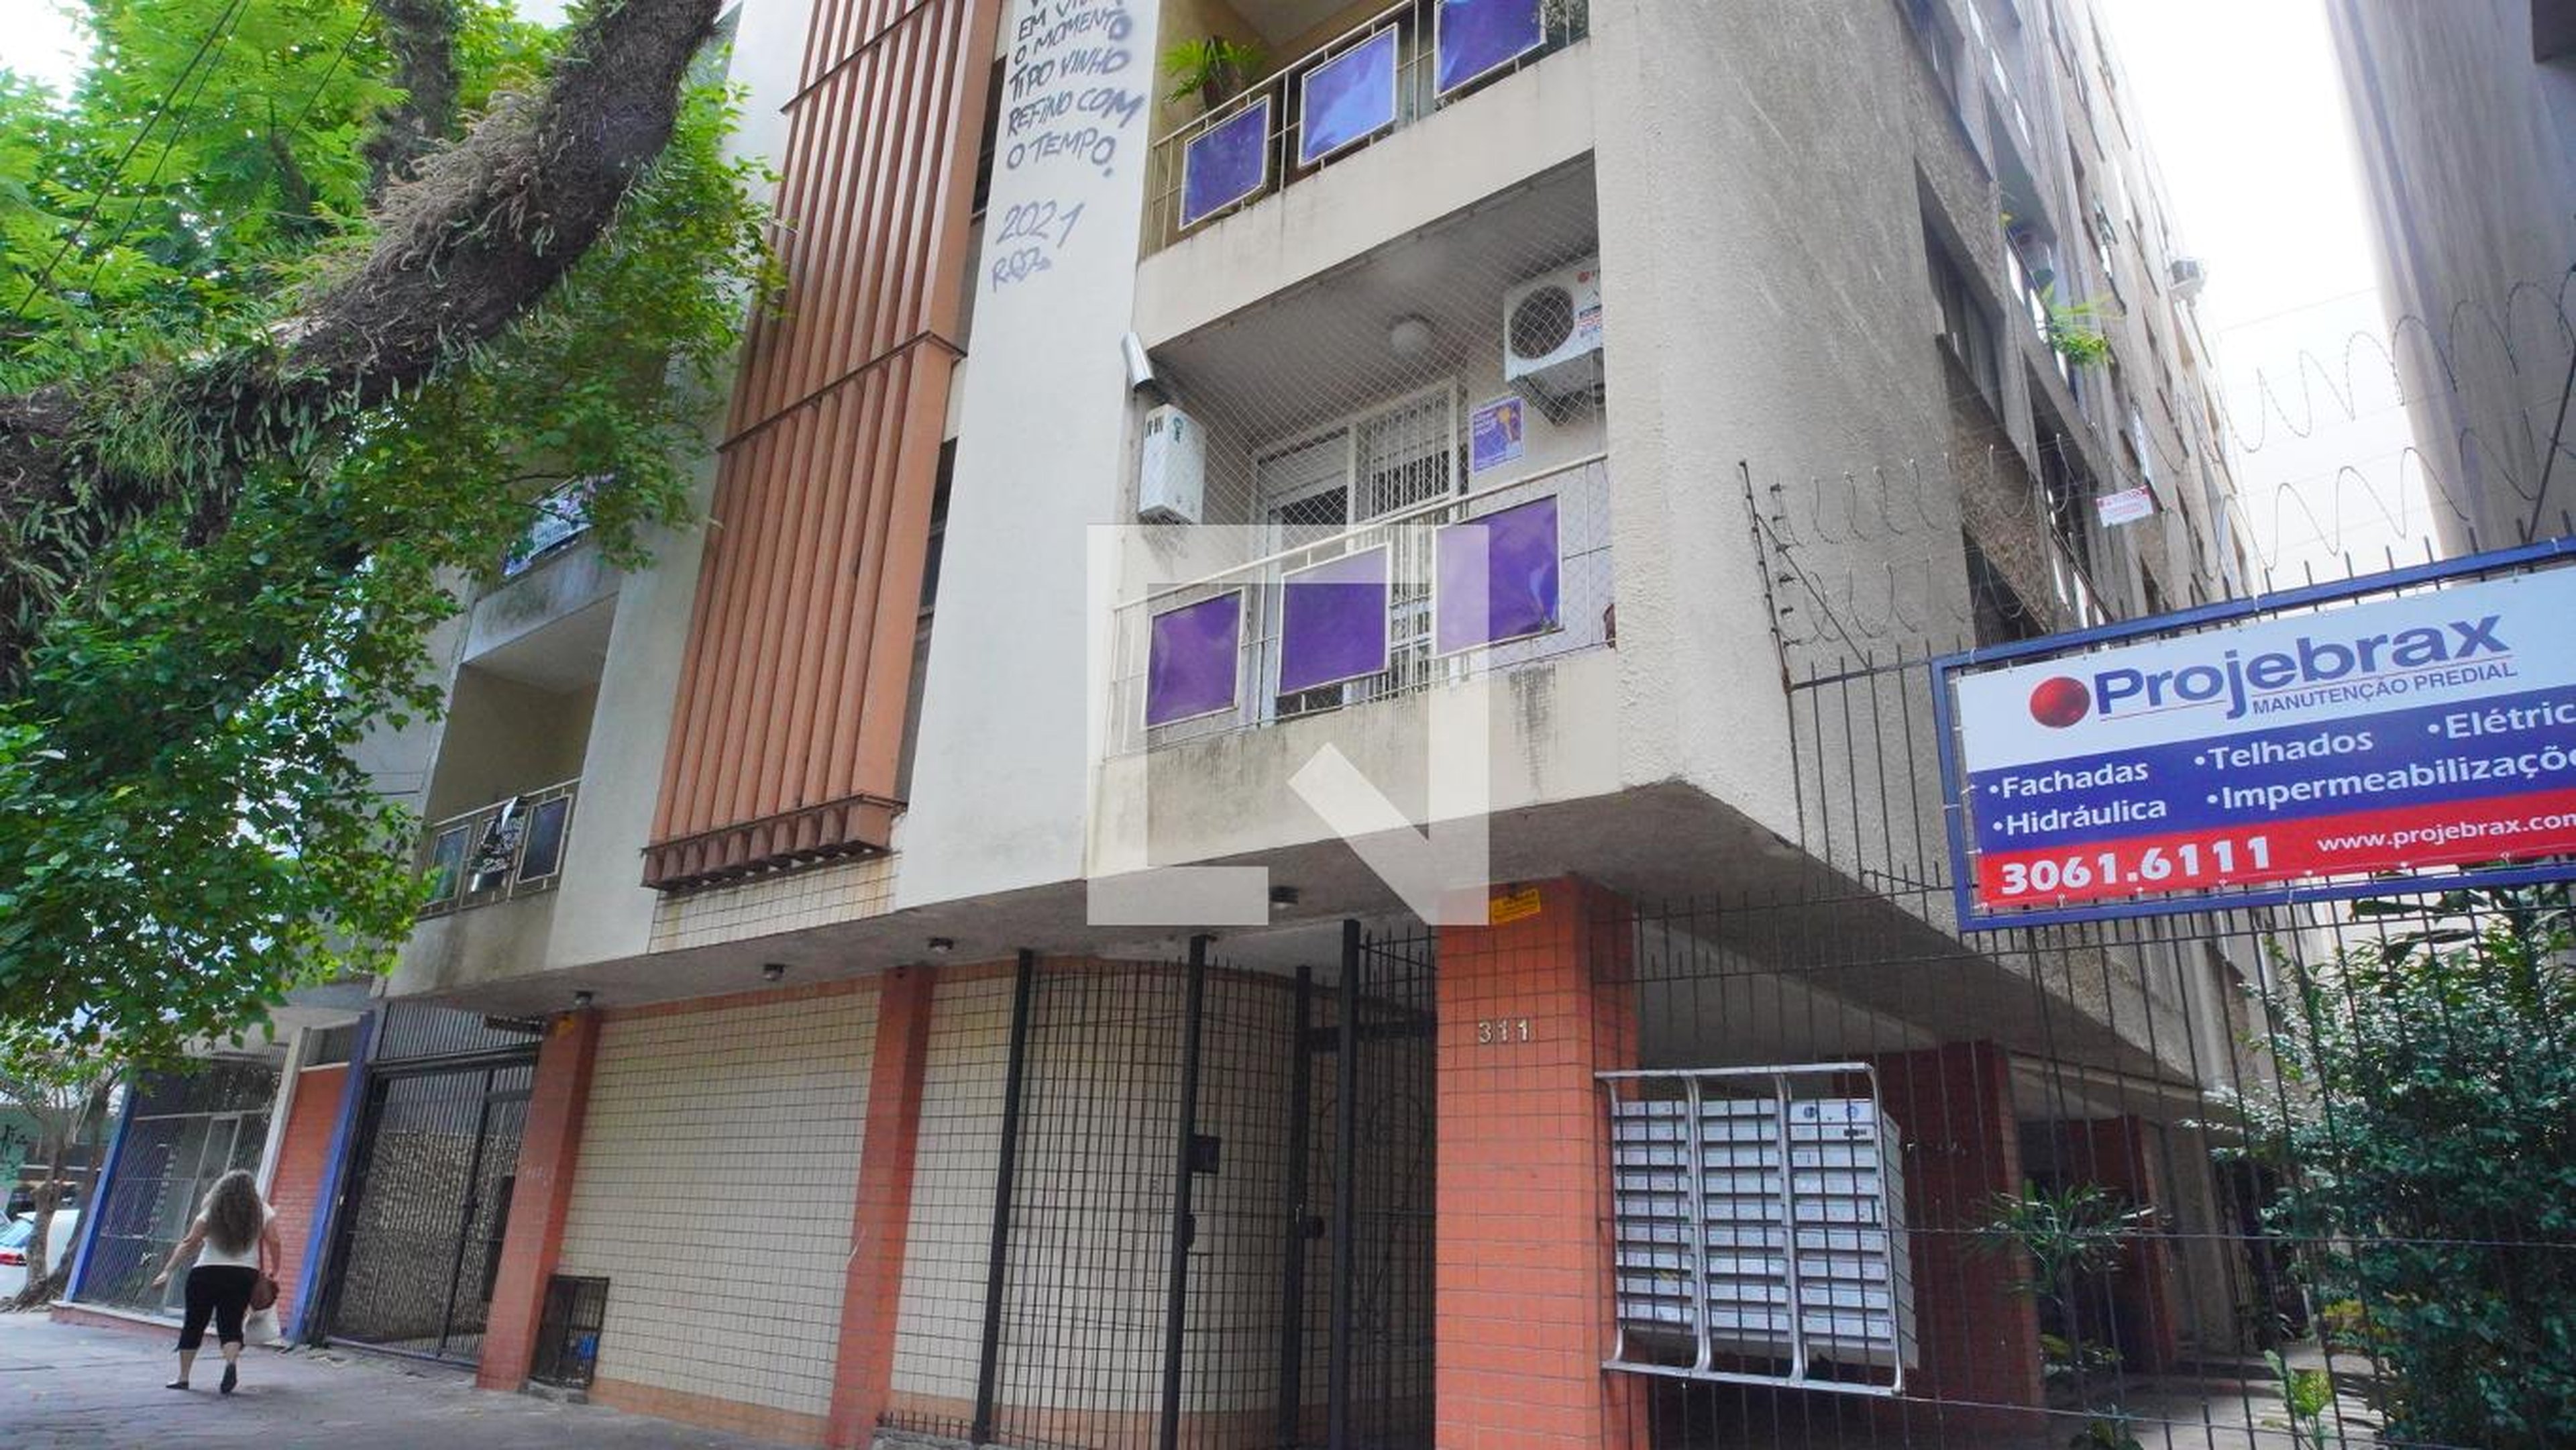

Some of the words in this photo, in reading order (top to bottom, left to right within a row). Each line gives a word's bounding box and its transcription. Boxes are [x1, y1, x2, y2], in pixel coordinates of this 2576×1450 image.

[1009, 60, 1055, 102] TIPO
[1060, 47, 1131, 78] VINHO
[1077, 88, 1145, 128] COM
[1008, 144, 1025, 169] O
[996, 200, 1085, 248] 2021
[2094, 615, 2510, 721] Projebrax
[2415, 664, 2518, 692] PREDIAL
[2445, 701, 2576, 739] Elétric
[2207, 731, 2373, 770] Telhados
[2002, 762, 2148, 798] Fachadas
[2006, 798, 2167, 836] Hidráulica
[2001, 835, 2269, 895] 3061.6111
[1479, 1019, 1529, 1044] 311
